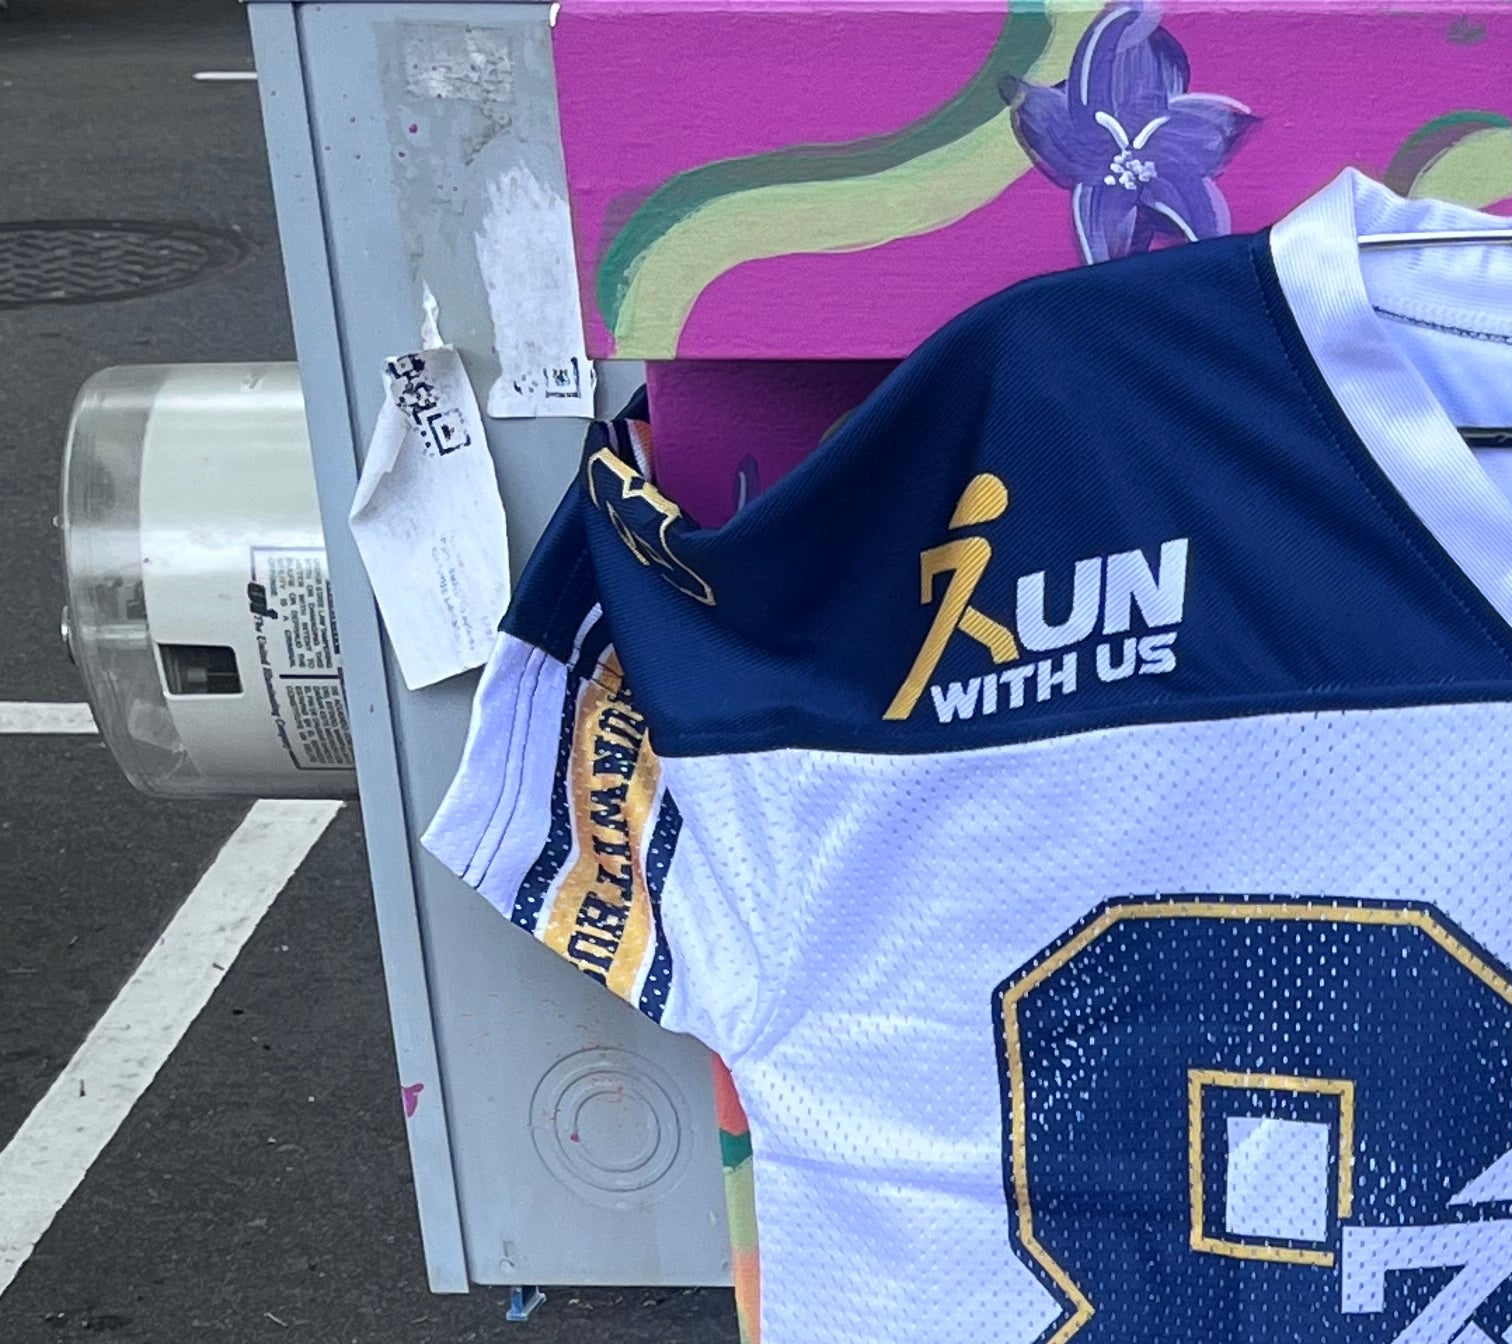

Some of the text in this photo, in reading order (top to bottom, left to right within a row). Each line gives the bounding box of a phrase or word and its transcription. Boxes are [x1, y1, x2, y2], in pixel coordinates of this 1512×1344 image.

[930, 632, 1177, 723] WITH US
[569, 690, 648, 988] UNWITHU
